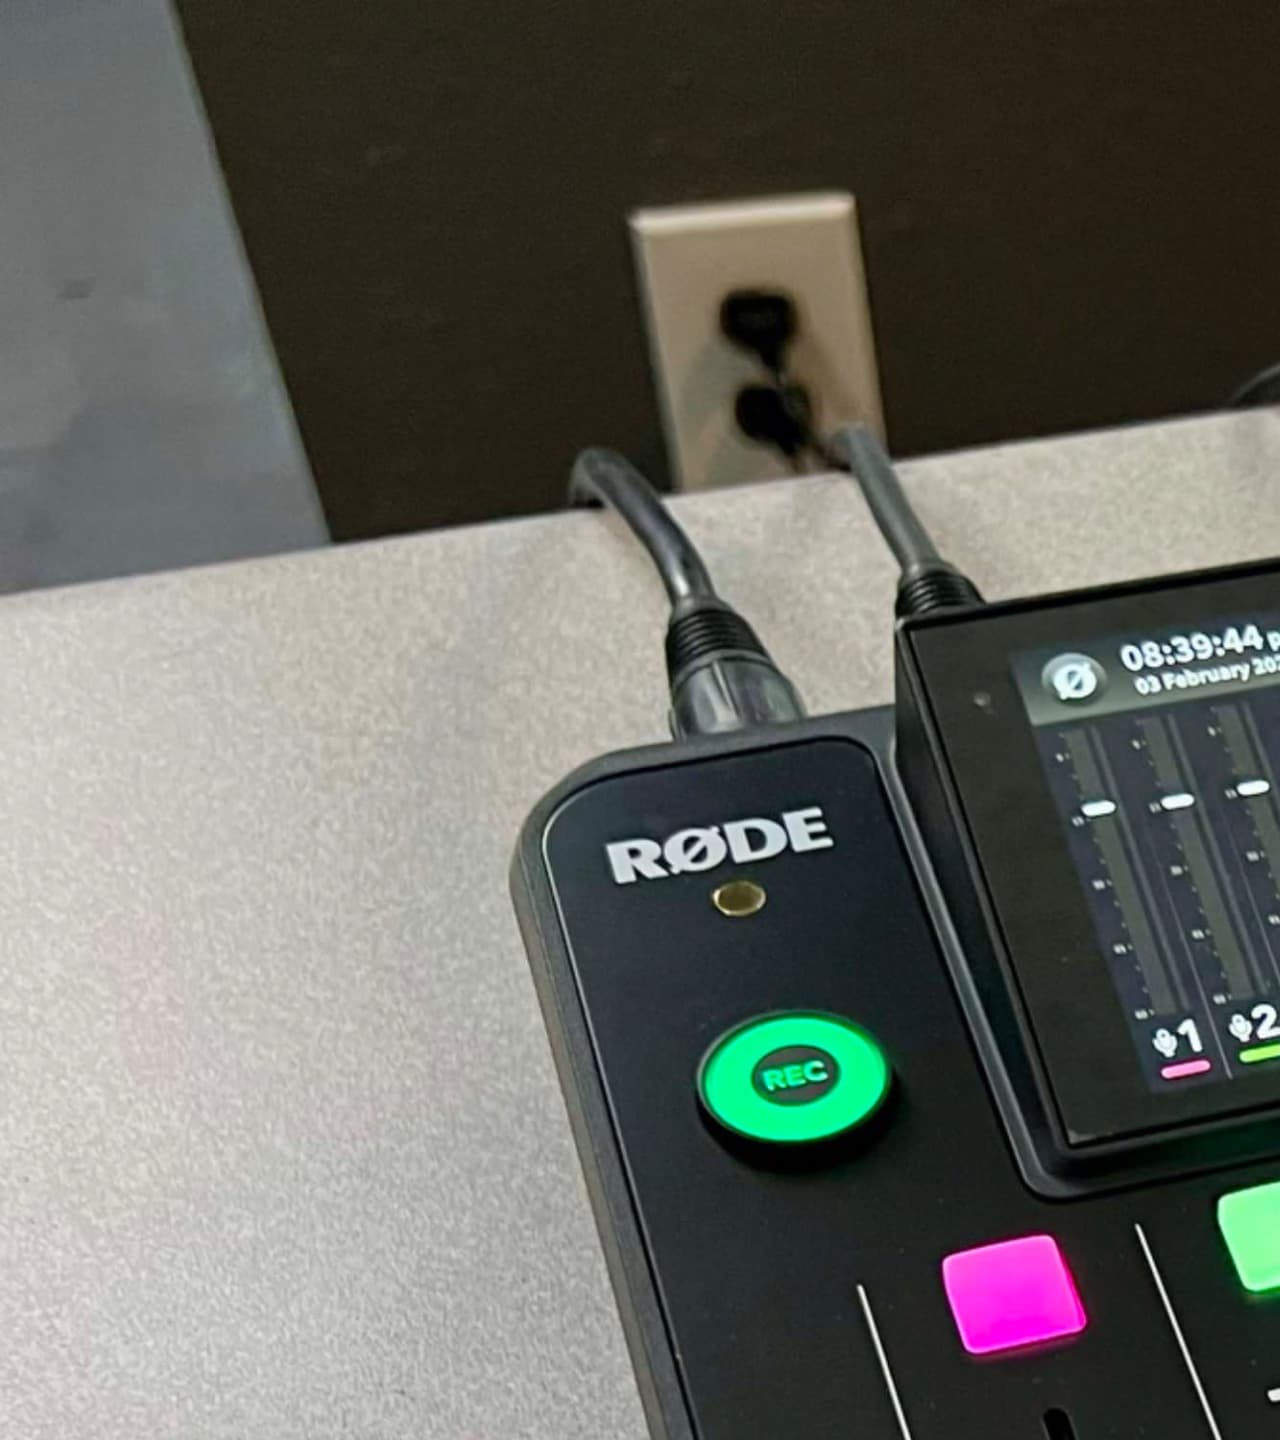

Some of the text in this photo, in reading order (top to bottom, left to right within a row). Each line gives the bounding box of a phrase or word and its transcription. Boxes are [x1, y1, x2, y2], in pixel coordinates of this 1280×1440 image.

[1120, 624, 1265, 672] 08:39:44
[1134, 674, 1161, 696] 03
[1162, 660, 1251, 691] February
[605, 805, 835, 885] RØDE
[1177, 1018, 1203, 1053] 1
[761, 1058, 830, 1092] REC
